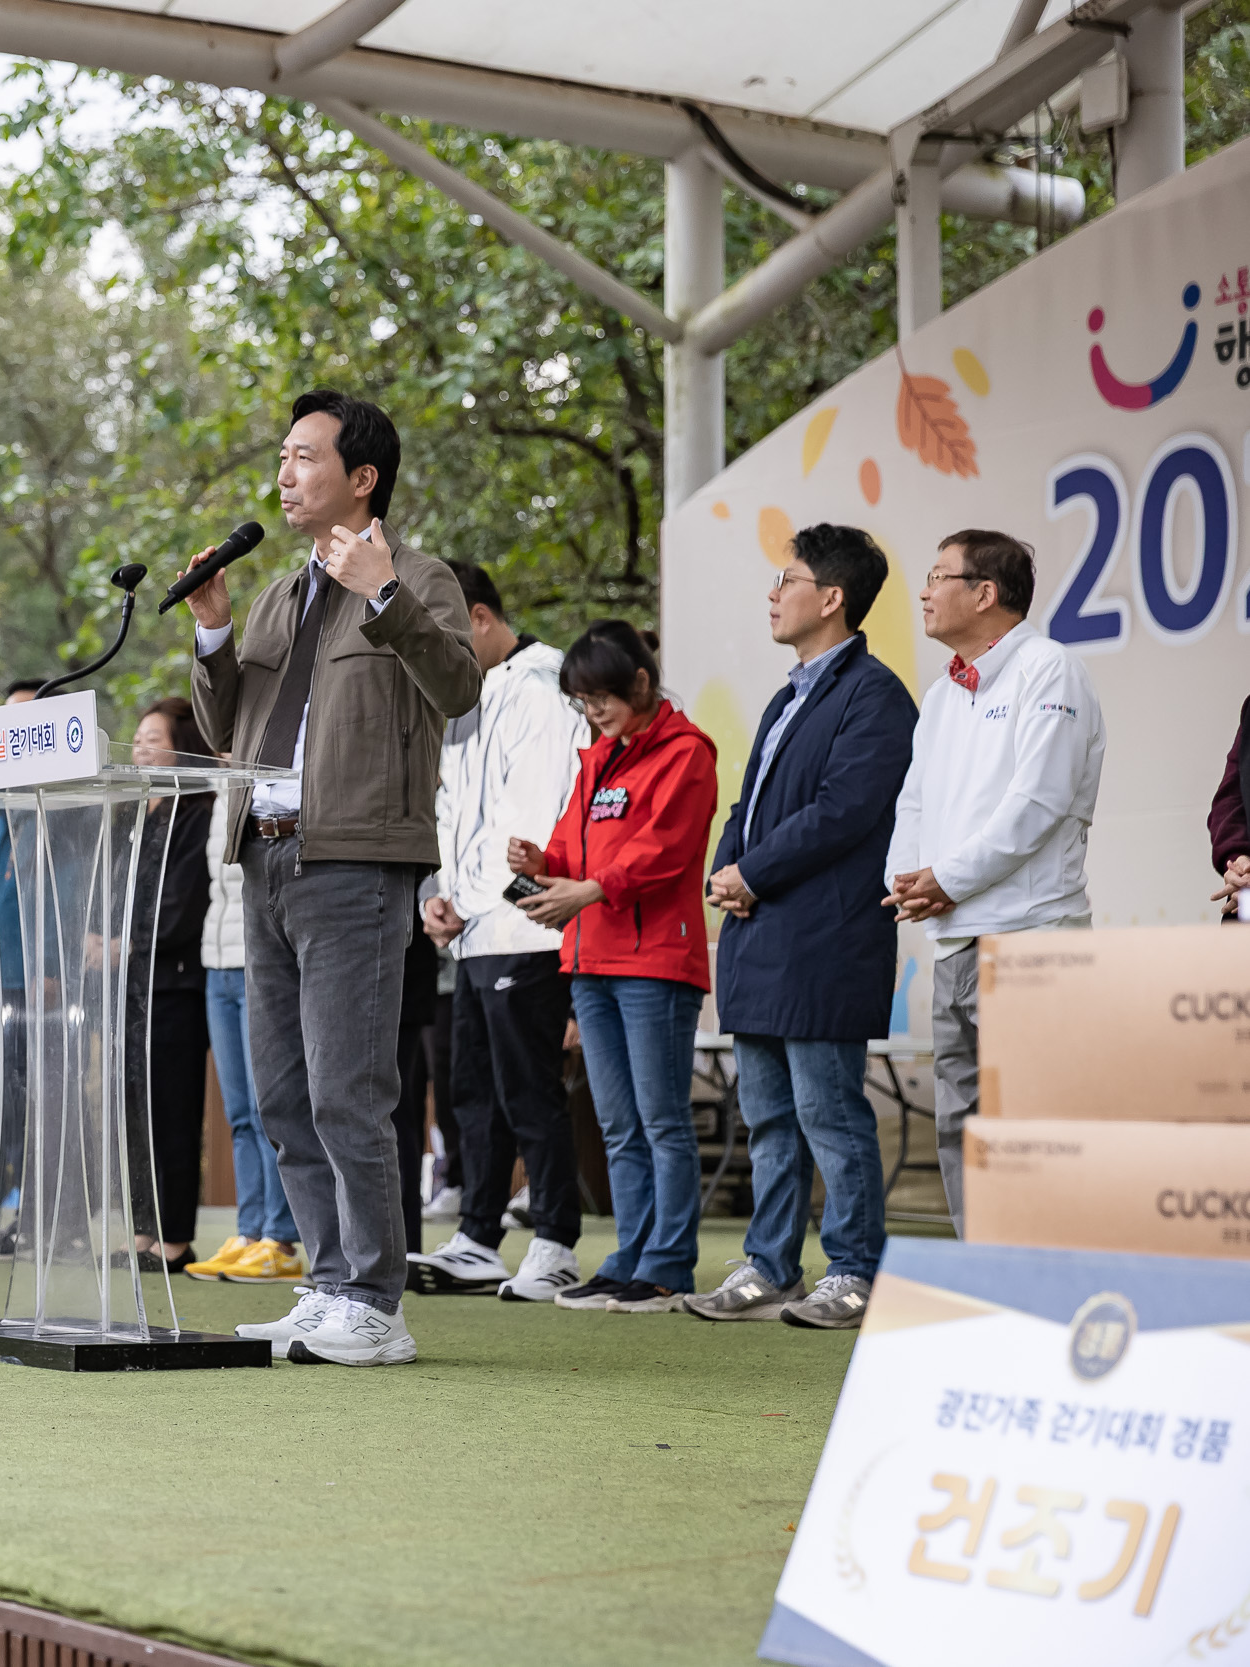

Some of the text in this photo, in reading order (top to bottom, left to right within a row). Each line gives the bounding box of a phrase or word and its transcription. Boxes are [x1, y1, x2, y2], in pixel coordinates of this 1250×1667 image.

[1048, 446, 1250, 645] 20
[8, 722, 55, 757] 걷기대회
[936, 1388, 1233, 1464] 광진가족 걷기대회 경품
[907, 1472, 1182, 1618] 건조기
